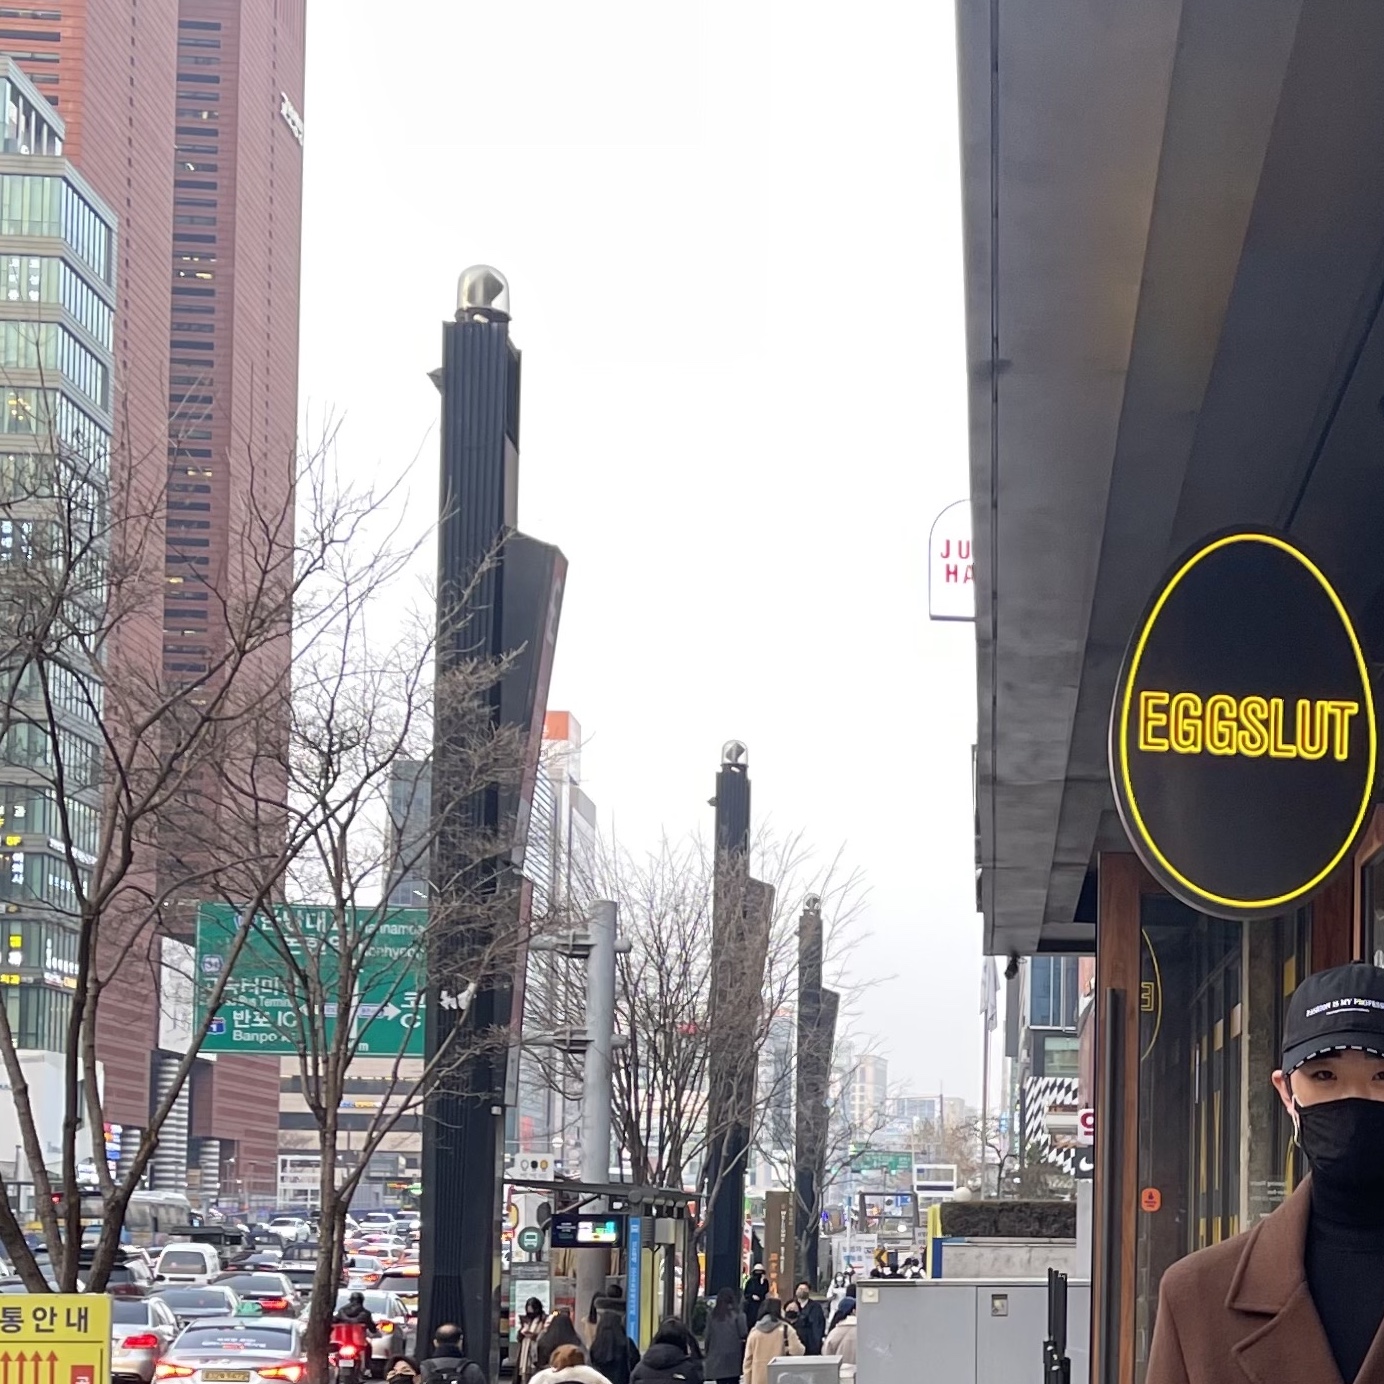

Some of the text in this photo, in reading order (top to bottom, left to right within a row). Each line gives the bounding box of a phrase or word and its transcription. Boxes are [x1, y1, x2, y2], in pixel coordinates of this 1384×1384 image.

[1139, 690, 1359, 762] EGGSLUT
[1340, 998, 1353, 1006] MY
[233, 1029, 278, 1043] Banpo
